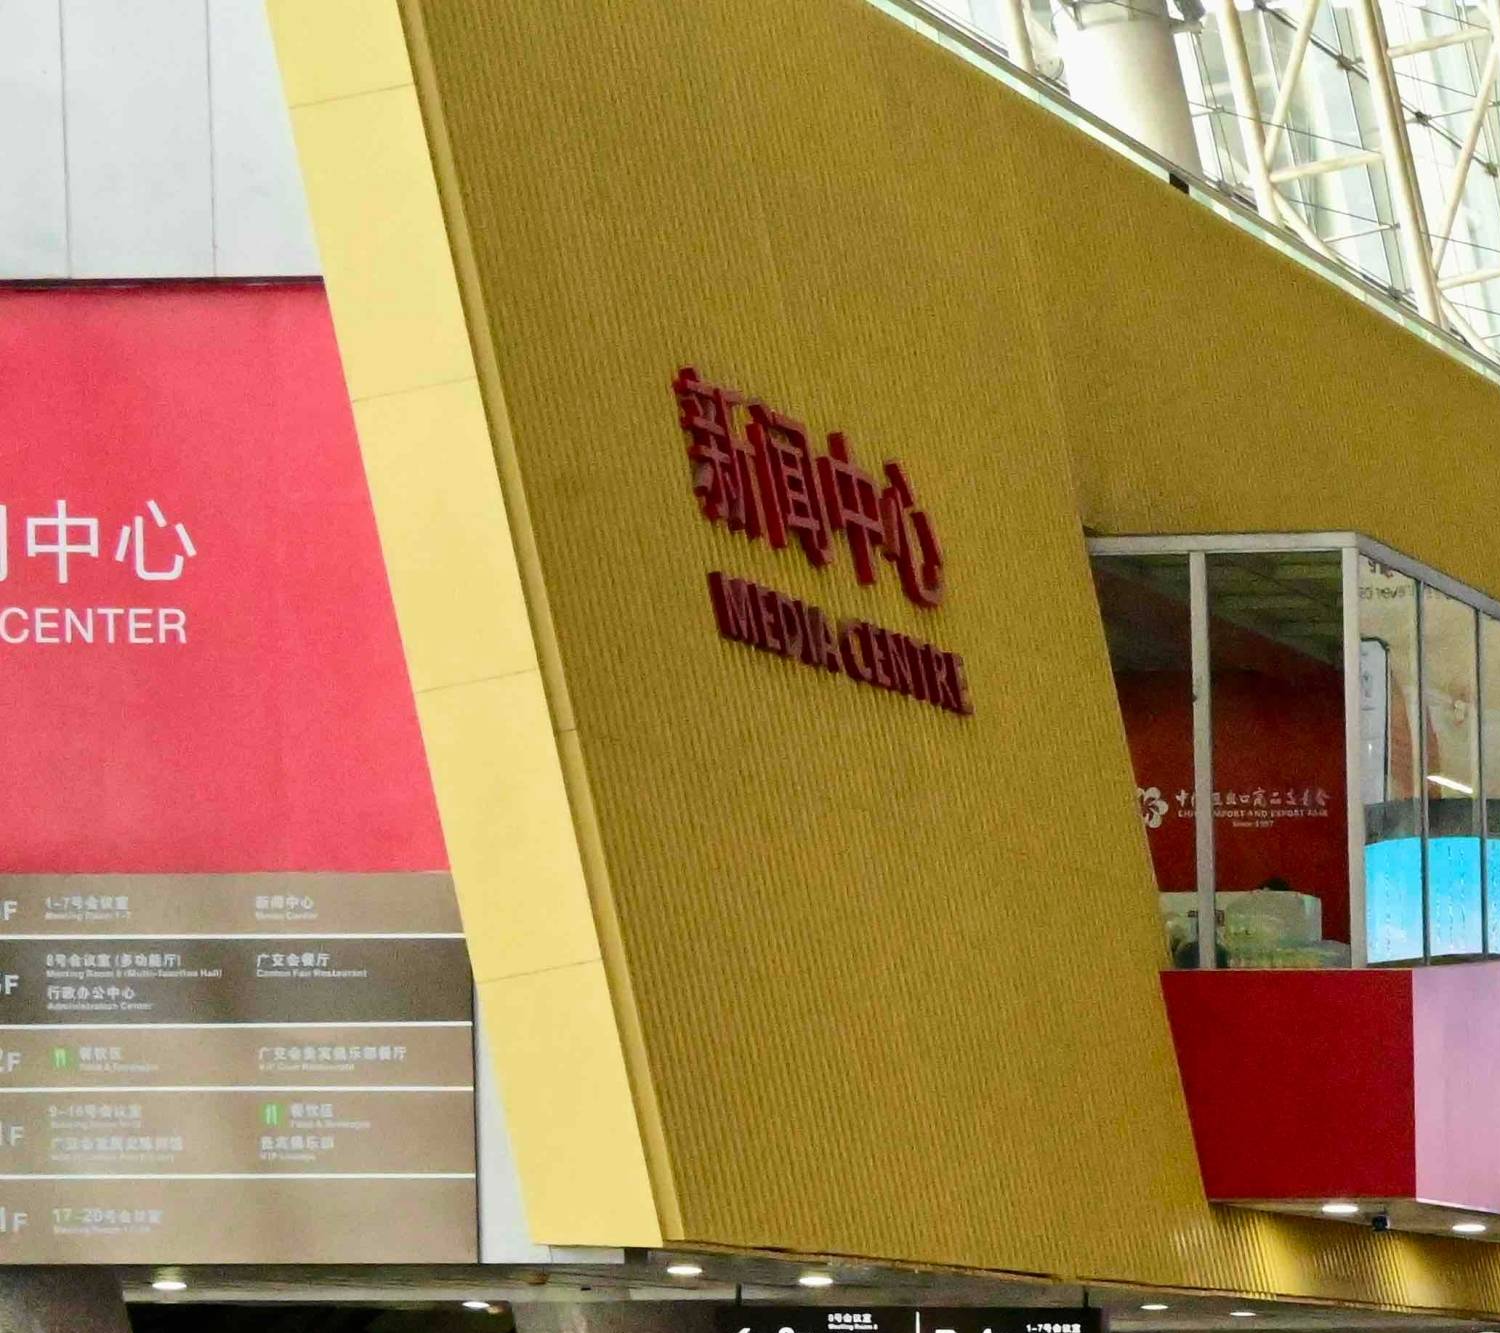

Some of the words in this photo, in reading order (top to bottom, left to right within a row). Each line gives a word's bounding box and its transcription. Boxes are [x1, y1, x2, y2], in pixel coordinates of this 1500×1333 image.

[0, 499, 198, 584] 中心
[672, 366, 945, 608] 新闻中心
[0, 606, 188, 645] CENTER
[707, 570, 842, 672] MEDIA
[838, 618, 975, 716] CENTRE
